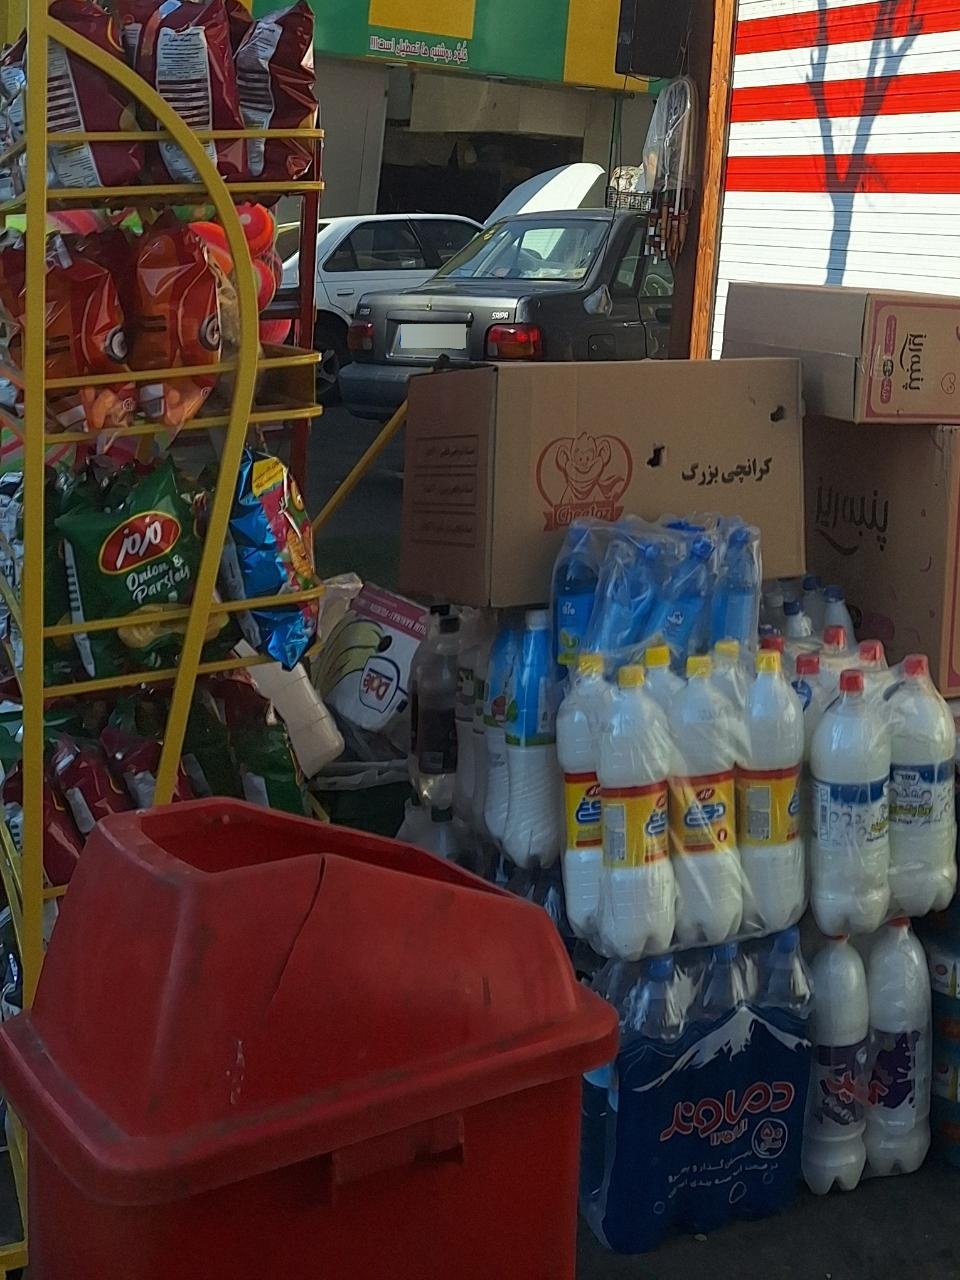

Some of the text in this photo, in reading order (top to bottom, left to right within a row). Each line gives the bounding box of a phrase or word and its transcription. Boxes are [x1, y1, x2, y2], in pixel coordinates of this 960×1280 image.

[681, 457, 773, 486] کرانچی بزرگ
[126, 554, 184, 591] Onion &
[132, 565, 190, 604] Parsley
[660, 1081, 795, 1141] دماوند
